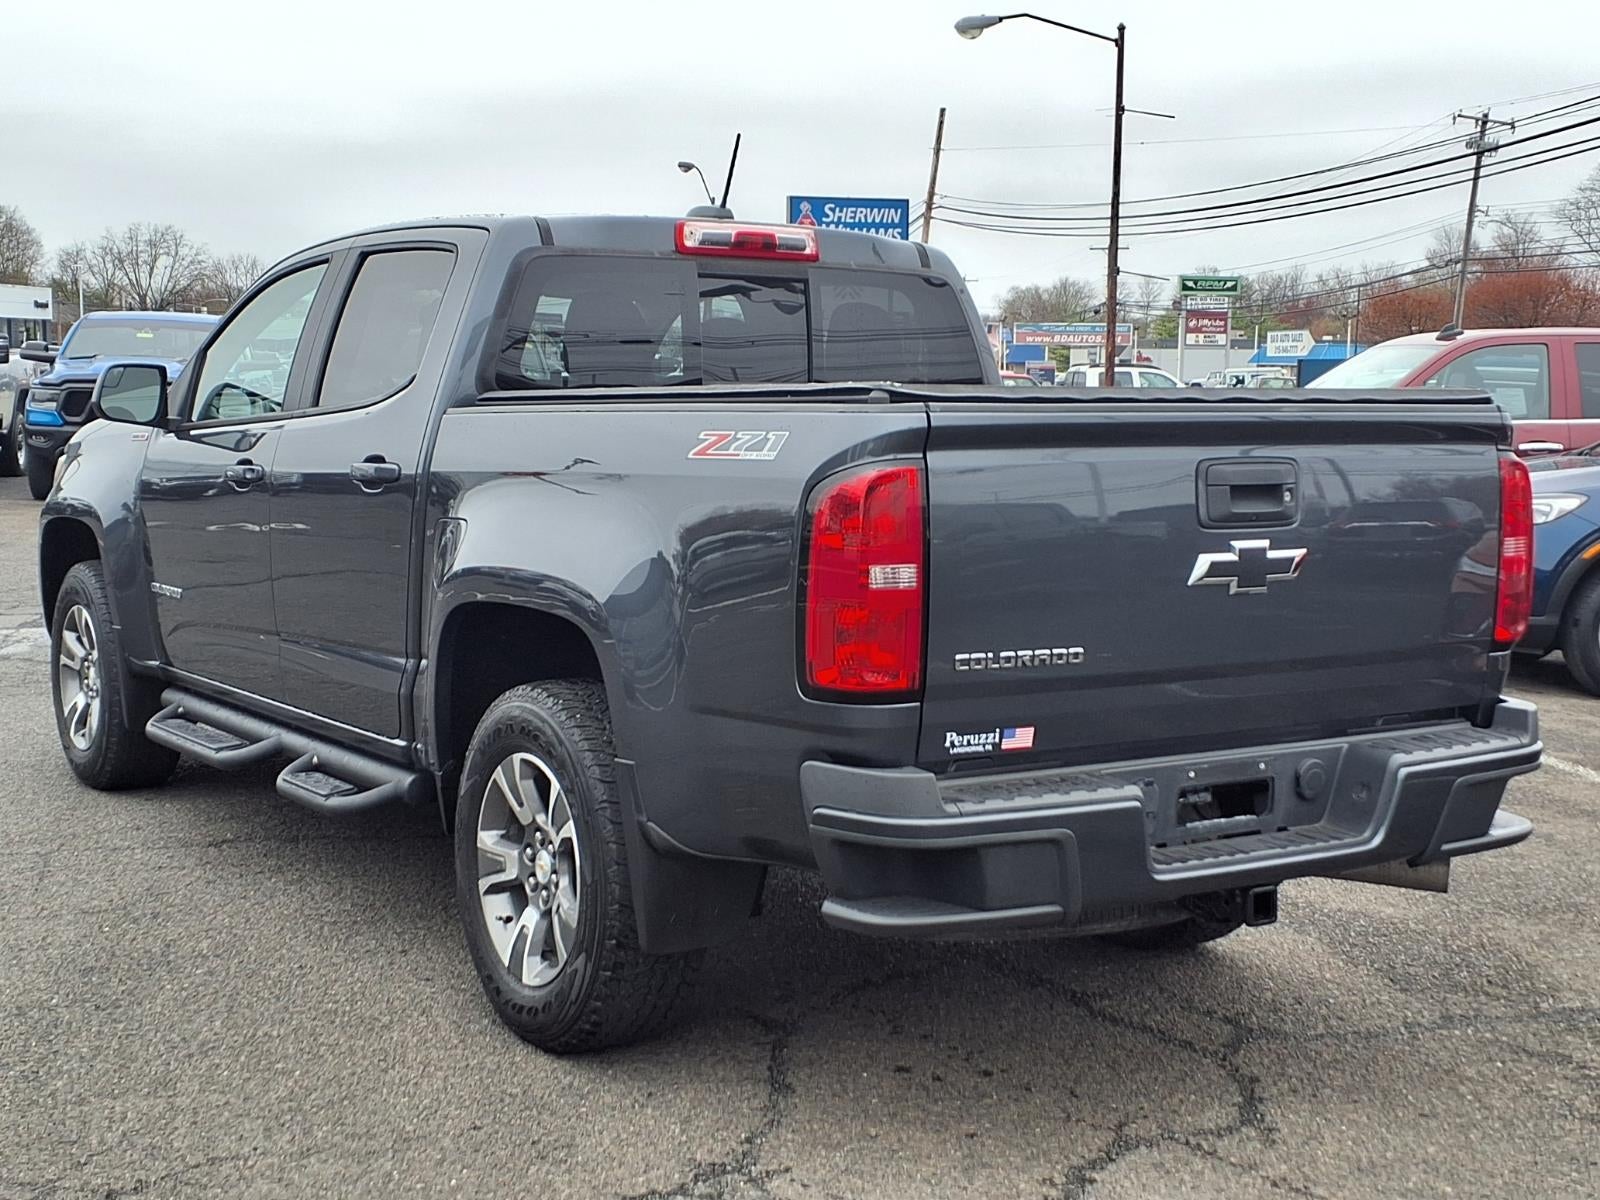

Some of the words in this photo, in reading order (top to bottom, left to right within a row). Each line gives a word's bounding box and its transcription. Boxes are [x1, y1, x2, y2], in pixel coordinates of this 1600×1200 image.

[822, 203, 902, 224] SHERWIN
[1196, 280, 1225, 288] RPM
[687, 431, 790, 460] Z71
[955, 647, 1085, 671] COLORADO
[944, 728, 1000, 747] Peruzzi
